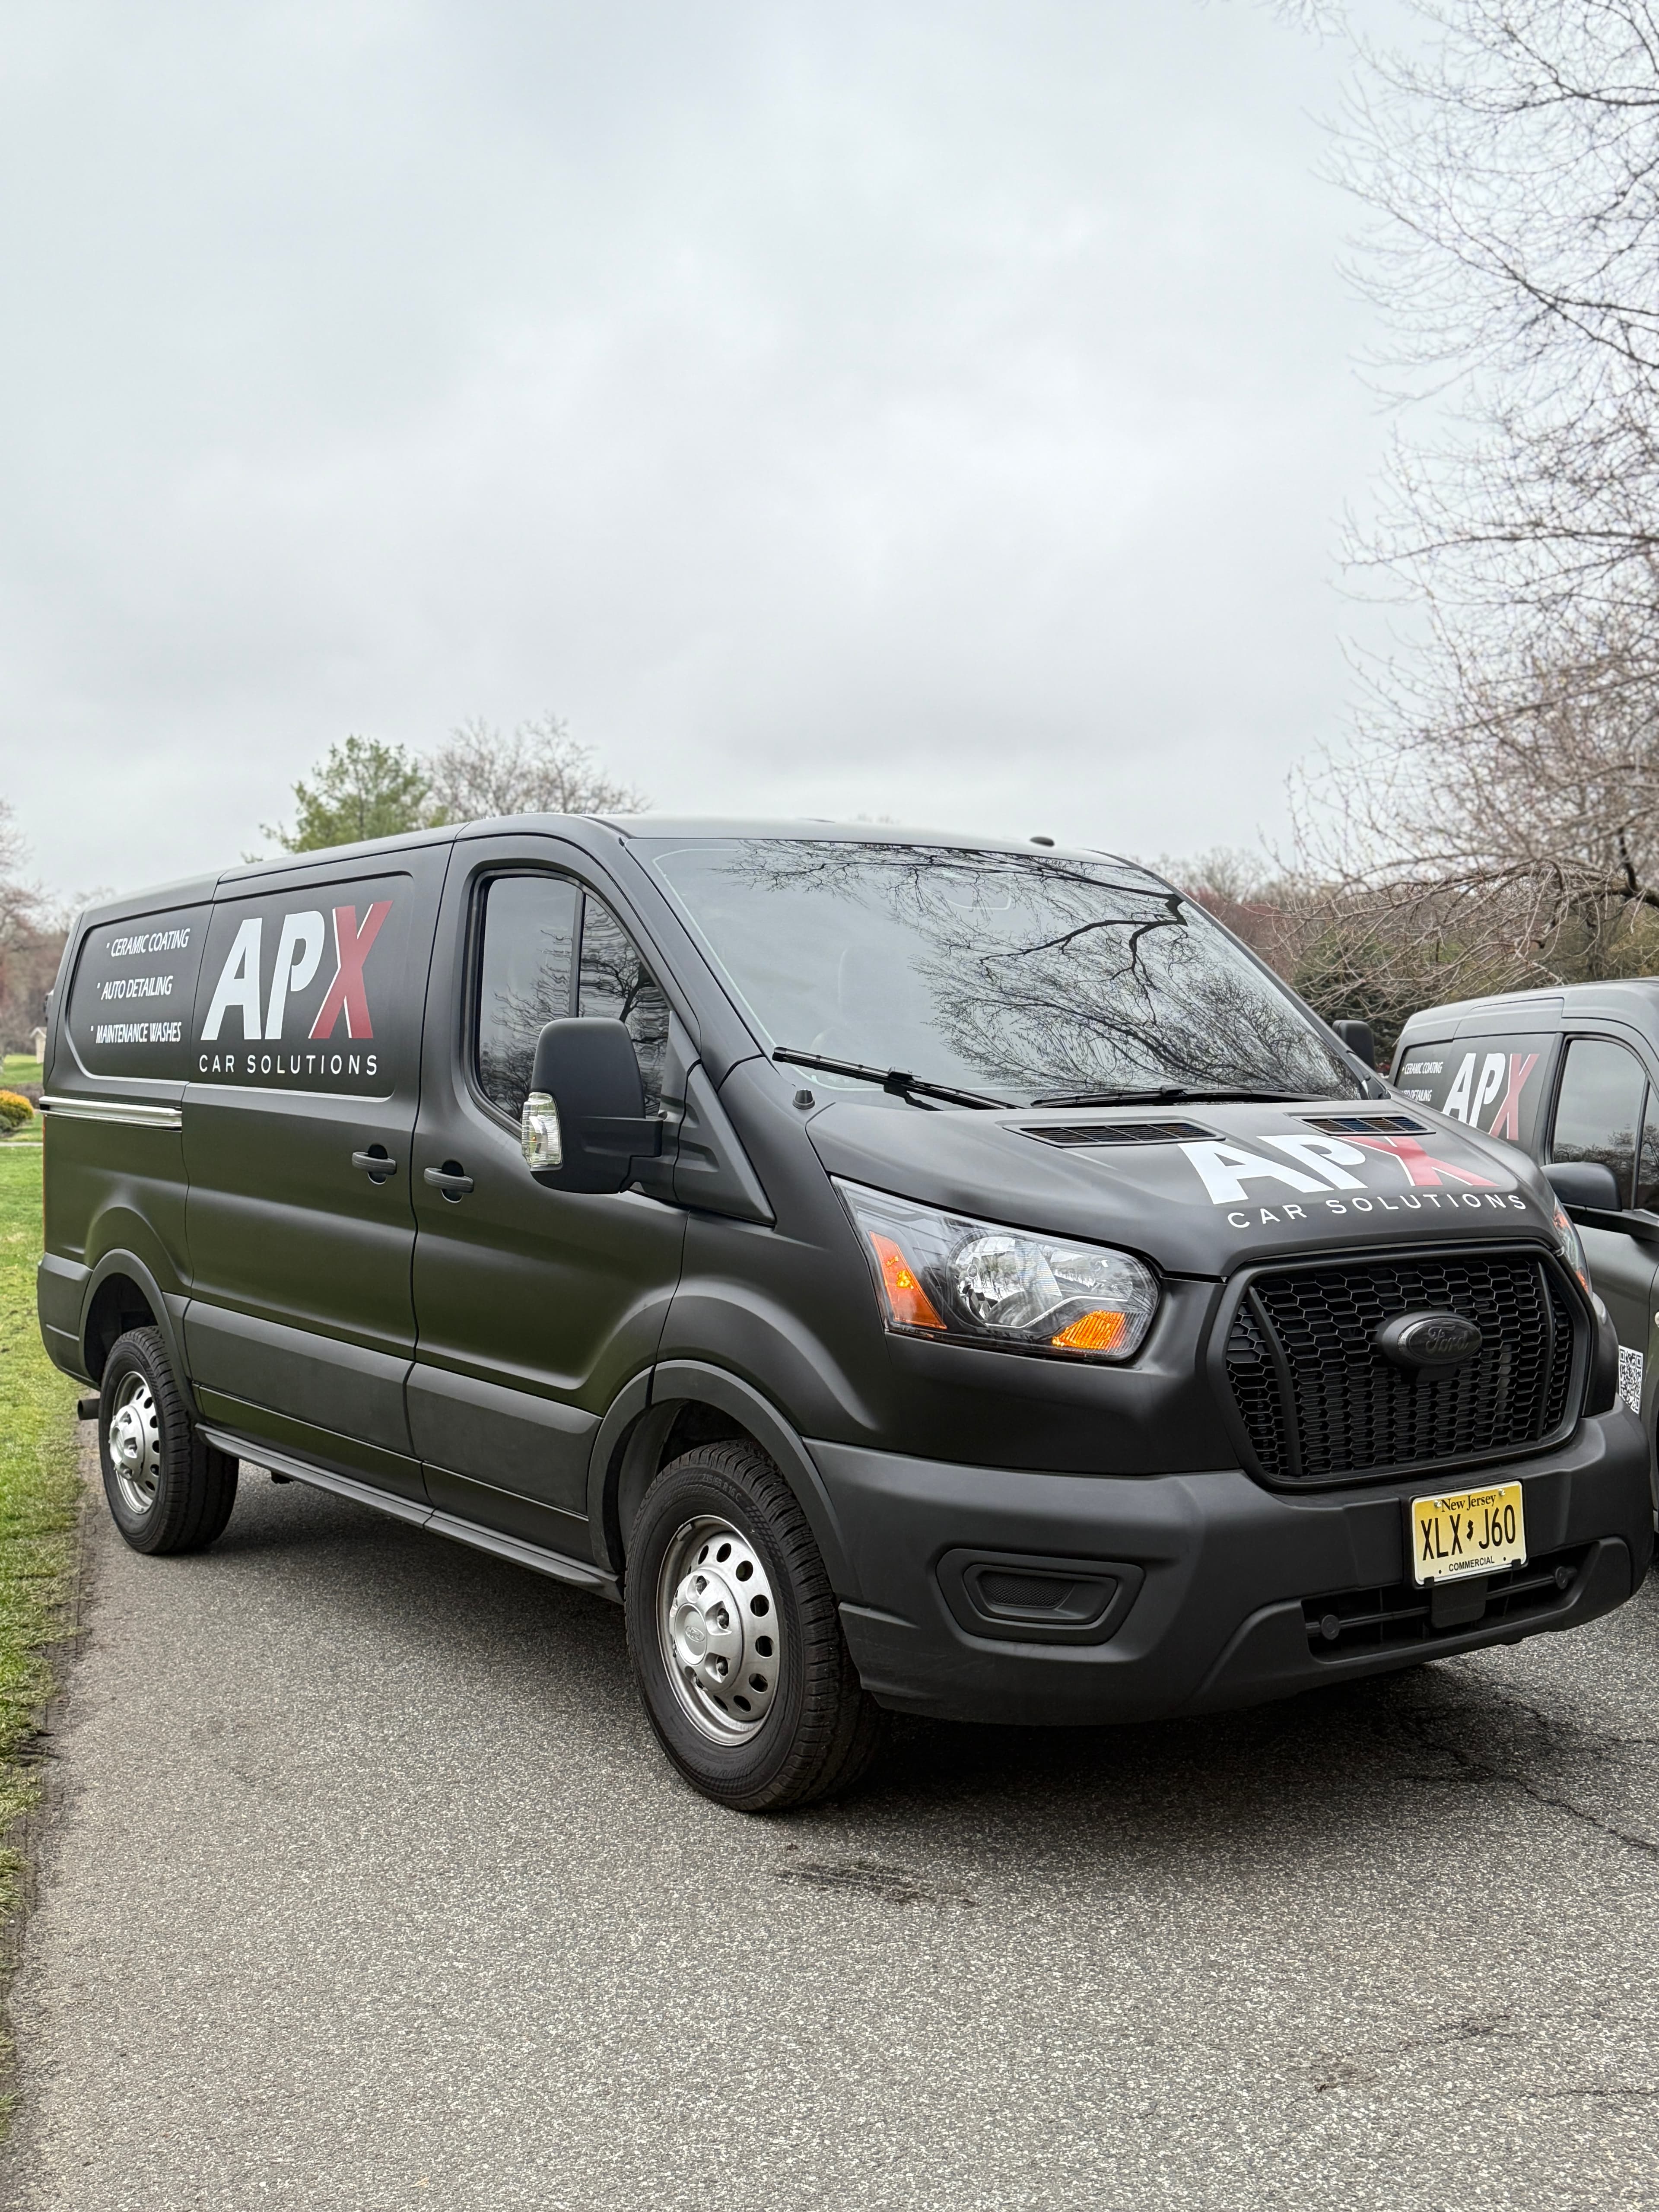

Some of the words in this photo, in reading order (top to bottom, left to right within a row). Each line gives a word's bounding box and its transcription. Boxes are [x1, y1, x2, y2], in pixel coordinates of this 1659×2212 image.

[111, 934, 149, 957] CERAMIC
[148, 928, 190, 952] COATING
[200, 900, 394, 1041] APX
[101, 980, 126, 1000] AUTO
[126, 976, 173, 998] DETAILING
[96, 1023, 149, 1043] MAINTENANCE
[150, 1022, 181, 1042] WASHES
[199, 1055, 235, 1073] CAR
[247, 1055, 377, 1075] SOLUTIONS
[1422, 1062, 1443, 1074] COATING
[1442, 1053, 1541, 1141] APX
[1177, 1134, 1501, 1205] APX
[1227, 1205, 1308, 1229] CAR
[1329, 1194, 1527, 1214] SOLUTIONS
[1426, 1325, 1469, 1354] Ford
[1441, 1498, 1465, 1513] New
[1466, 1494, 1496, 1511] Jersey
[1420, 1513, 1463, 1561] XLX
[1478, 1504, 1516, 1549] J60
[1449, 1555, 1495, 1572] COMMERCIAL
